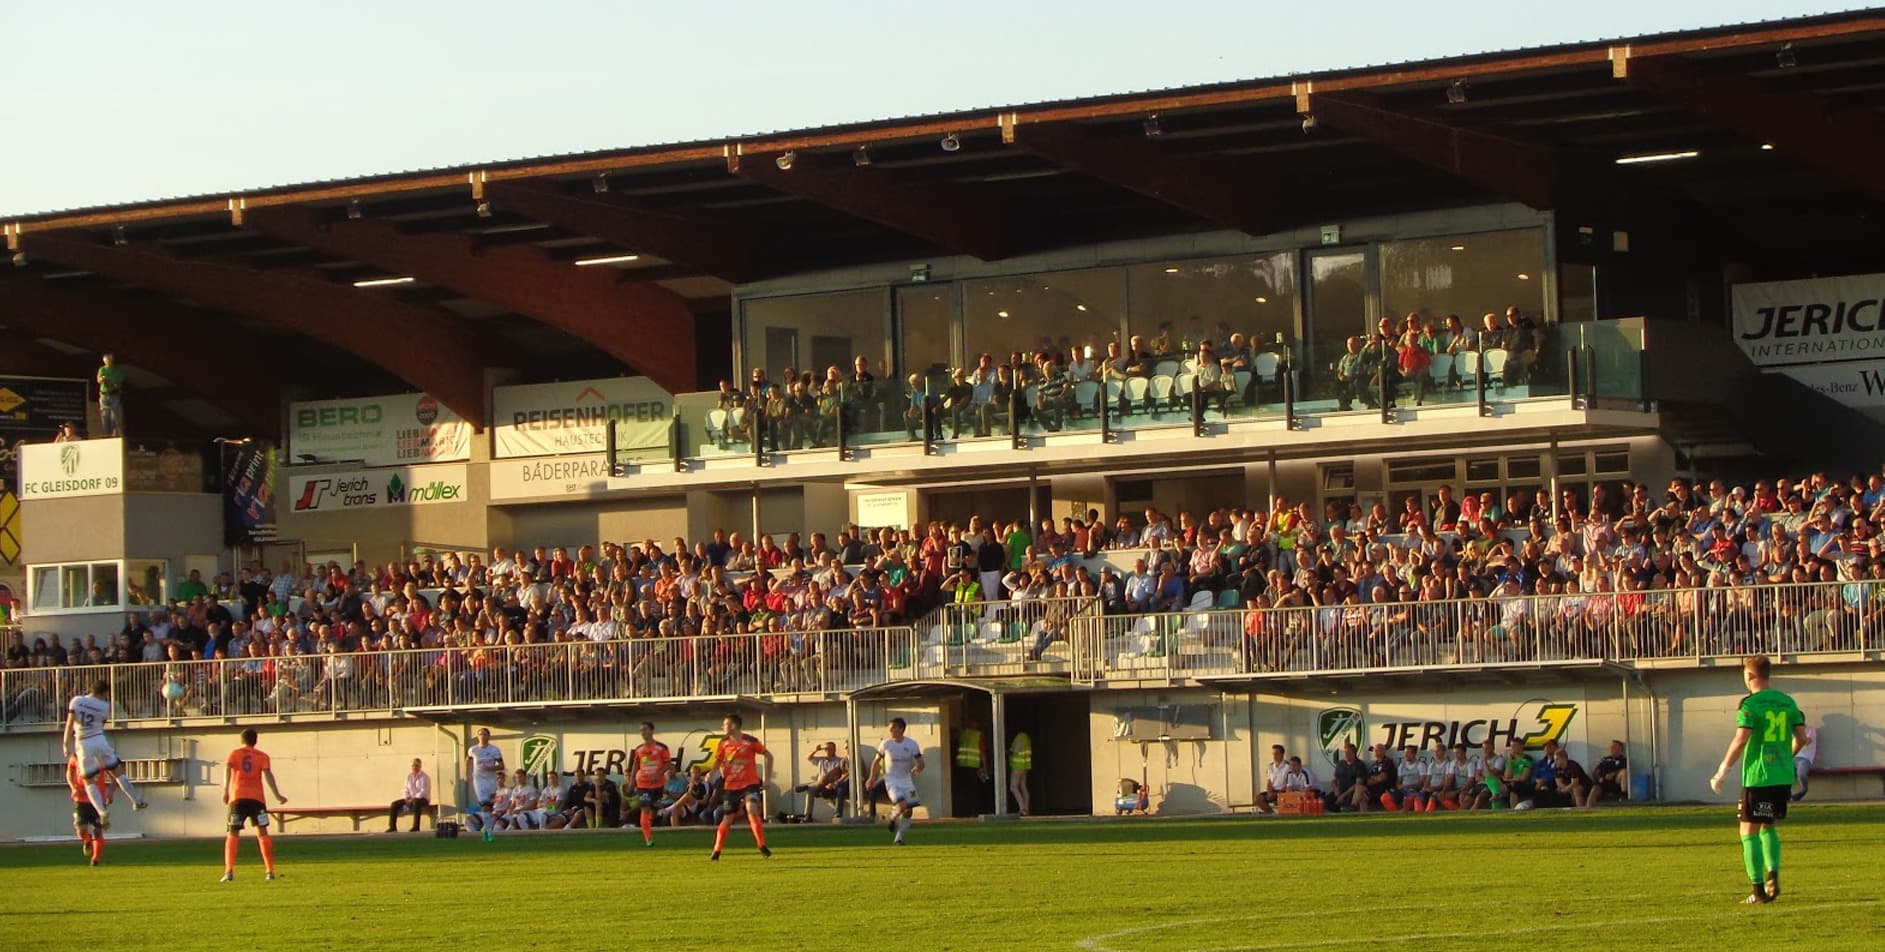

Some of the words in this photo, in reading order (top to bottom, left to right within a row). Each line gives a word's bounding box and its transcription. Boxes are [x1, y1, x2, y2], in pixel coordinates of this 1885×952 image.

[297, 403, 383, 428] BERO
[513, 401, 665, 432] REISENHOFER
[555, 431, 627, 447] HAUSTECHIK
[25, 482, 38, 495] FC
[41, 478, 102, 493] GLEISDORF
[105, 476, 119, 489] 09
[408, 481, 462, 502] müllex
[343, 492, 377, 506] trans
[79, 710, 95, 727] 12
[1764, 710, 1788, 742] 21
[1368, 718, 1518, 752] JERICH
[241, 754, 253, 774] 6
[563, 746, 685, 777] JERIH
